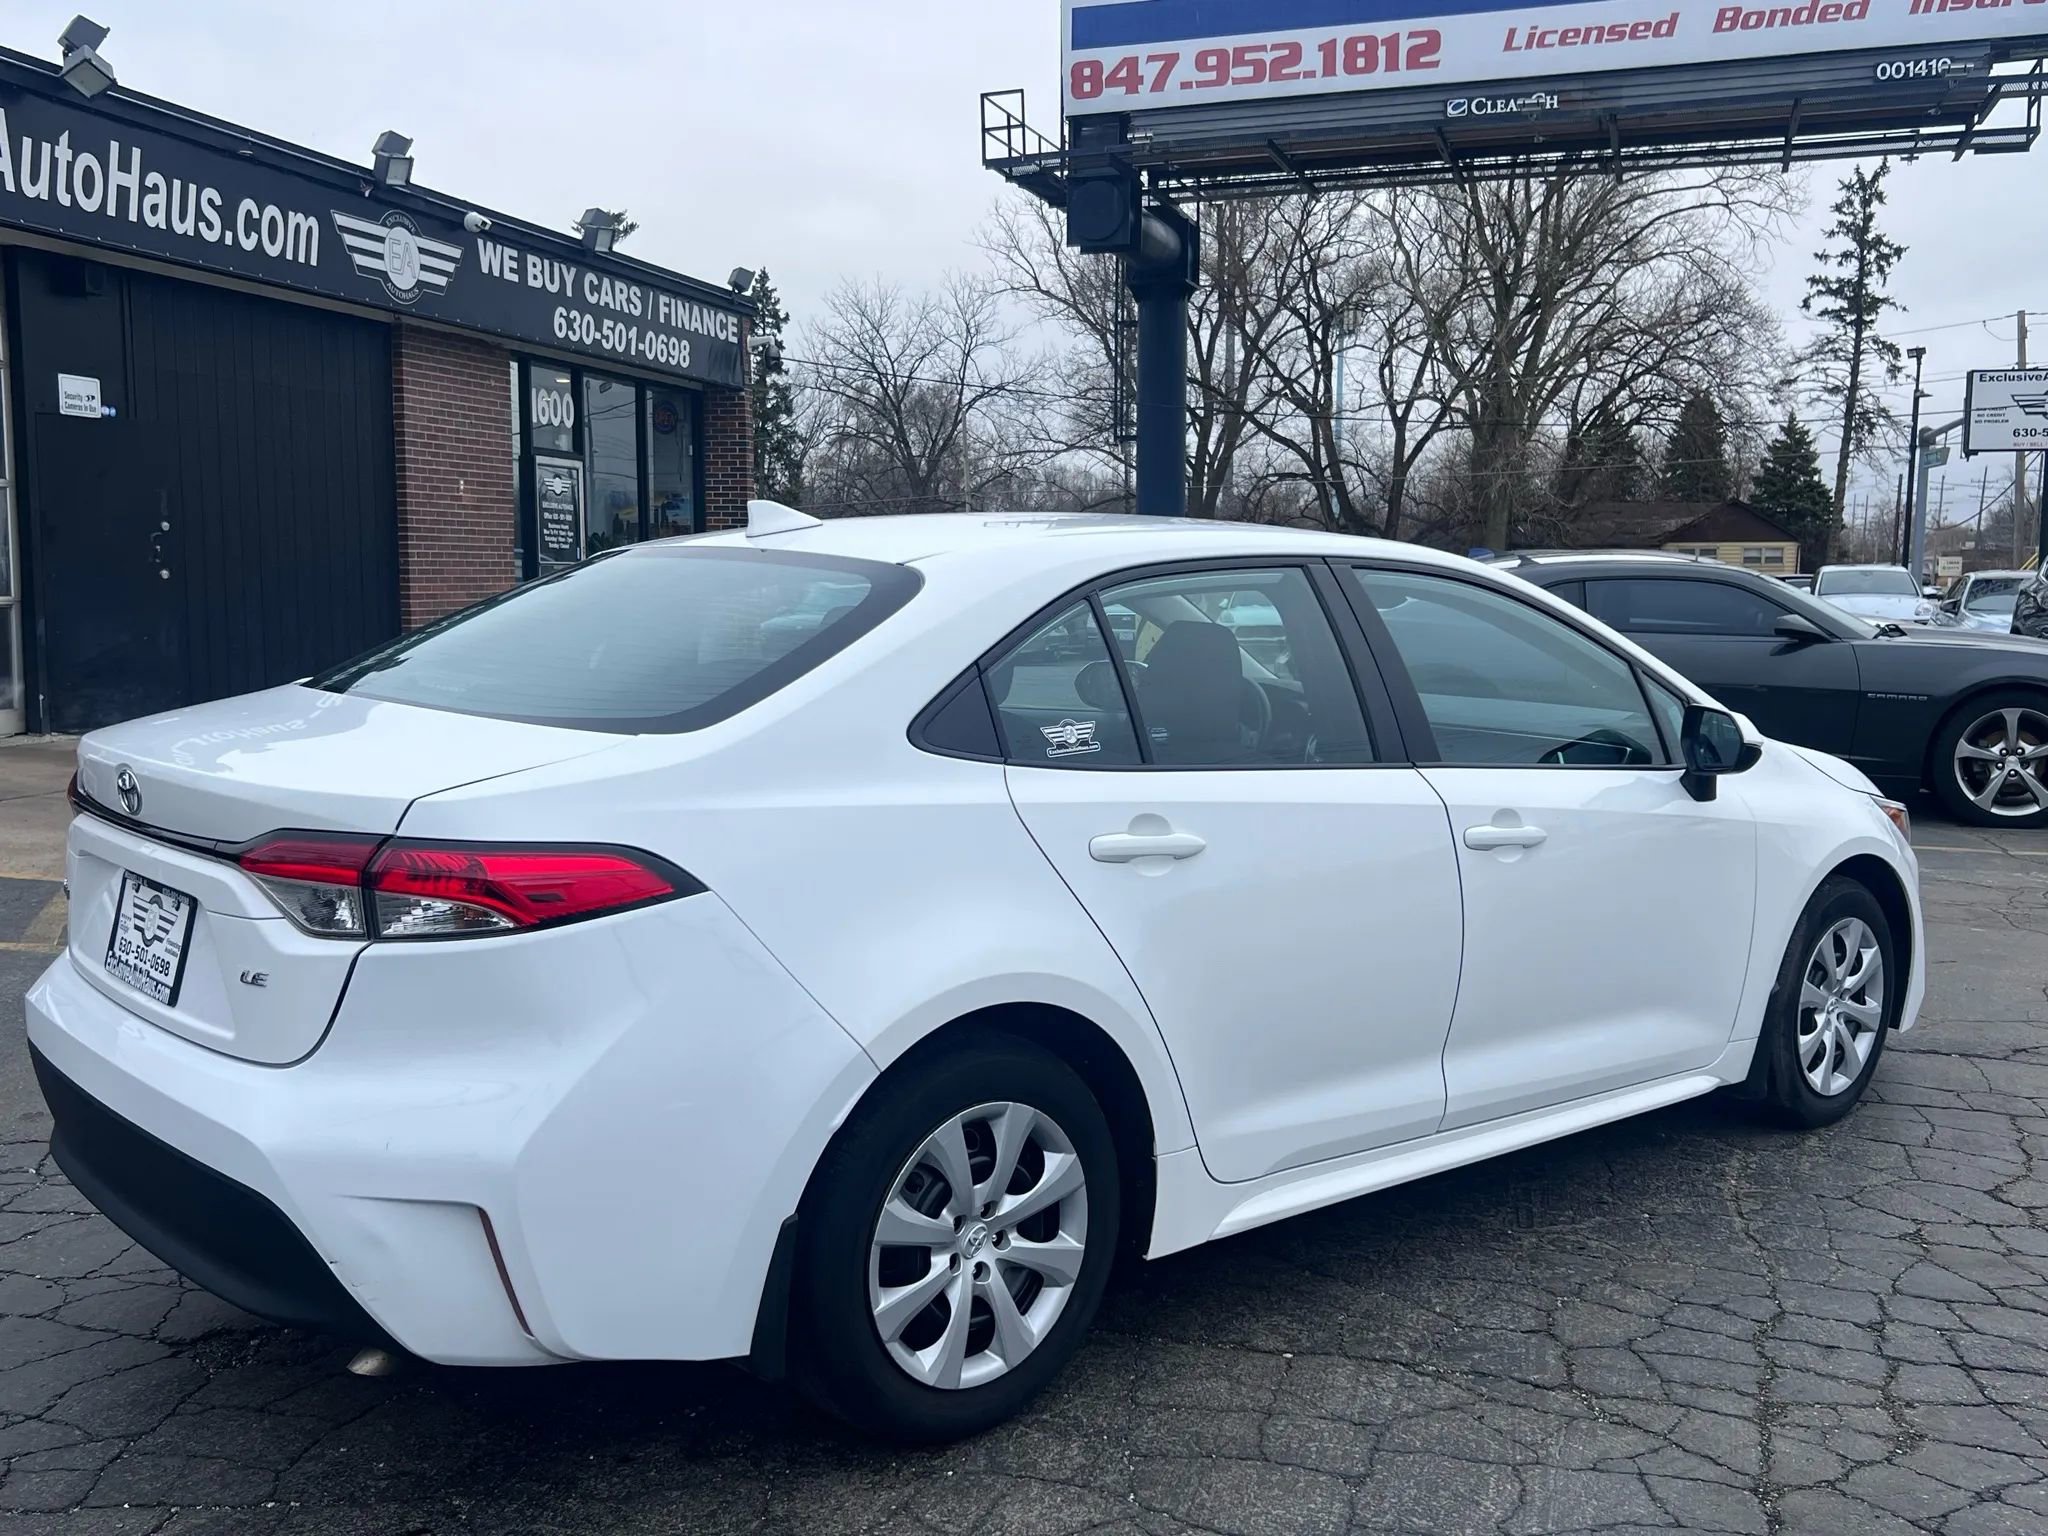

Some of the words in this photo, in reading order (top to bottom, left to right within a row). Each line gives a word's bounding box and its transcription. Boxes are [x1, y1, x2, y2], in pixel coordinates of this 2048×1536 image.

[1502, 12, 1680, 52] Licensed
[1713, 0, 1871, 33] Bonded
[1071, 29, 1442, 100] 847.952.1812
[1470, 97, 1522, 115] CLEA
[476, 238, 519, 283] WE
[527, 253, 577, 298] BUY
[584, 273, 643, 317] CARS
[647, 293, 653, 320] /
[659, 295, 738, 344] FINANCE
[553, 306, 691, 369] 630-501-0698
[531, 388, 575, 430] 1600
[119, 936, 171, 977] 630-501-0698
[239, 969, 270, 988] LE
